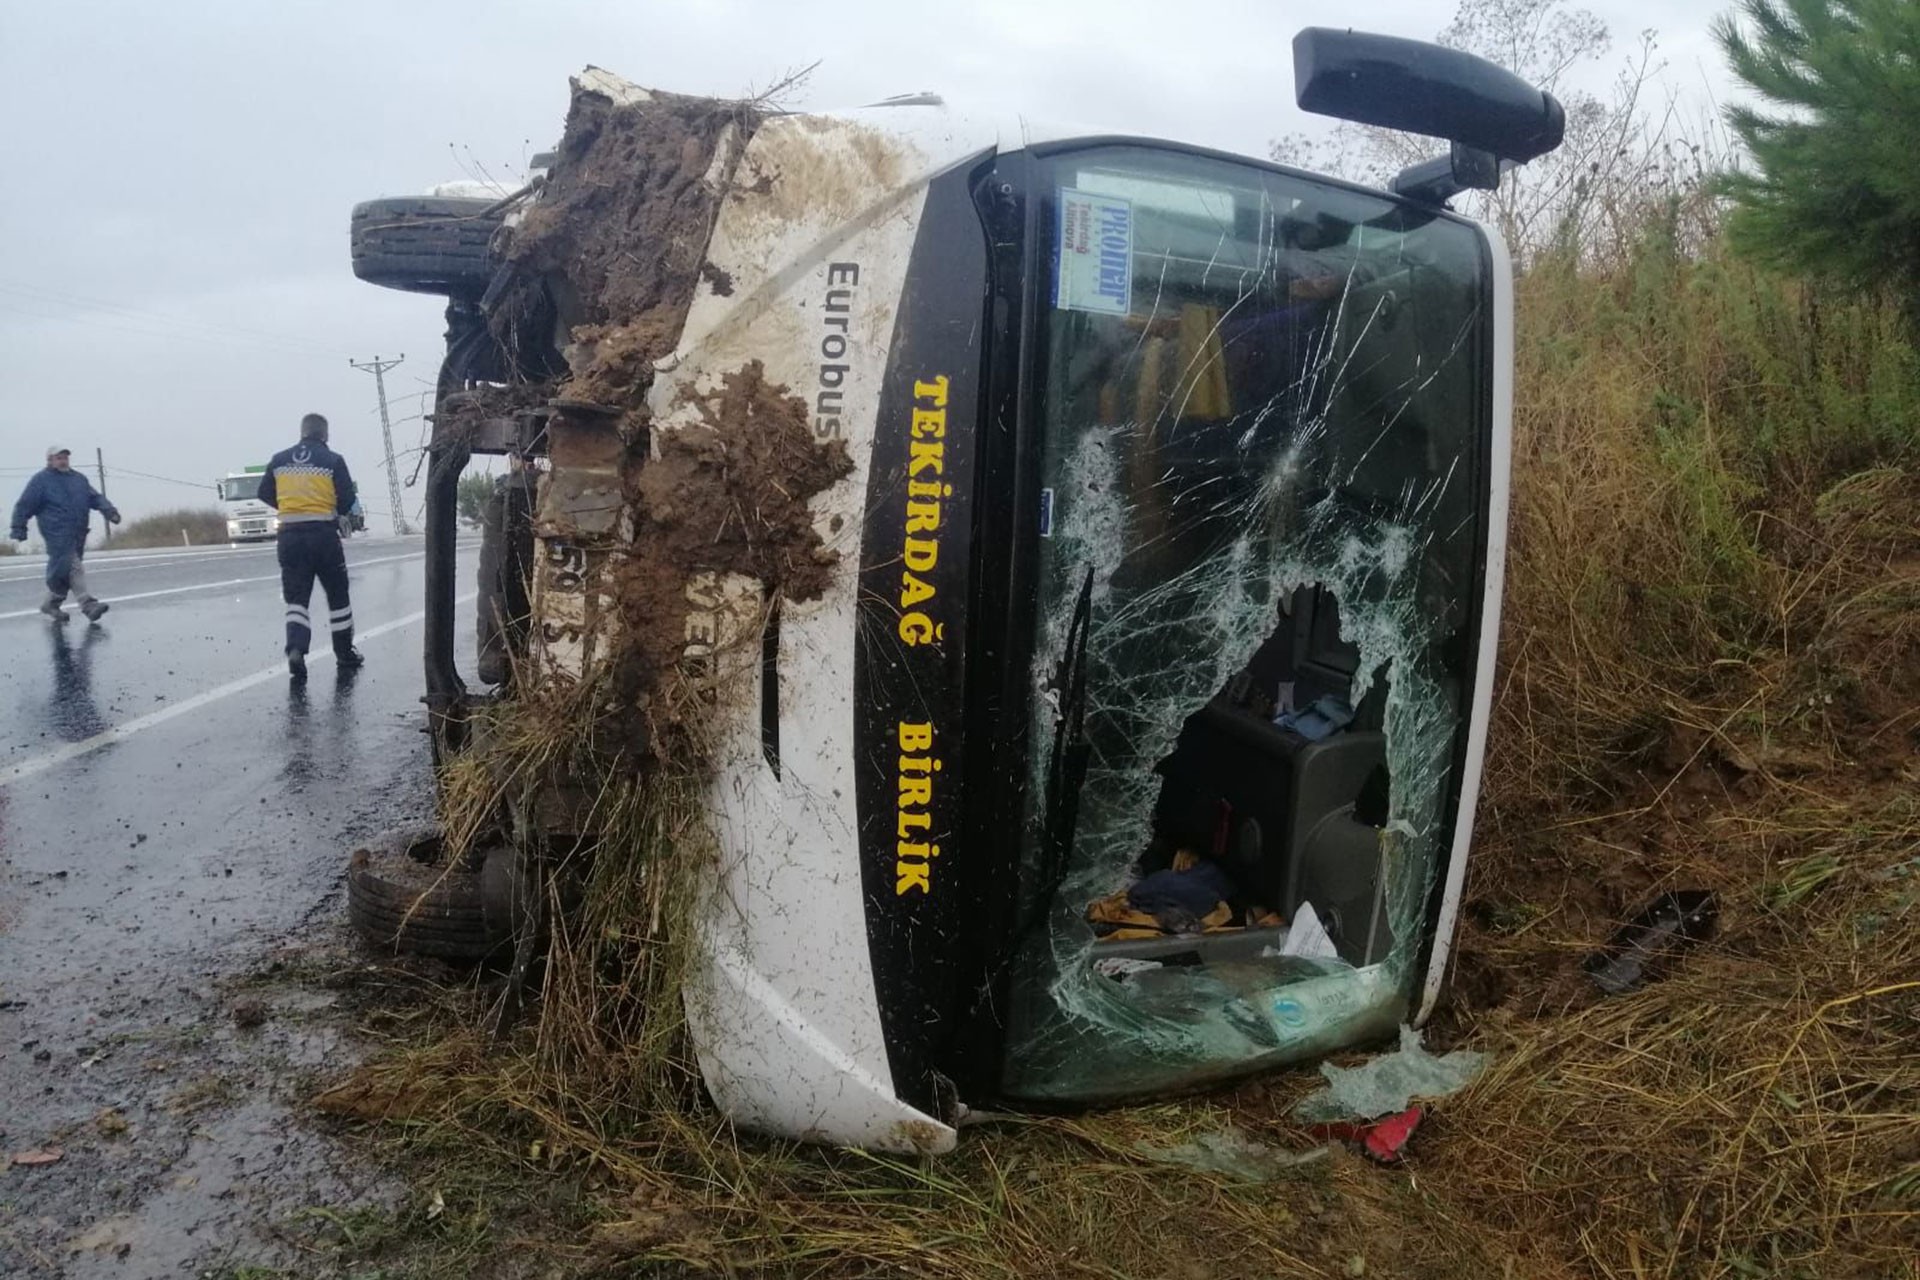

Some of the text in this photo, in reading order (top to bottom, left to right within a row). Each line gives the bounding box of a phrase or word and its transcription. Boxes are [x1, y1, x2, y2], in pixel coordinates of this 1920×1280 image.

[815, 262, 860, 439] Eurobus
[896, 375, 952, 896] TEKİRDAĞ BİRLİK
